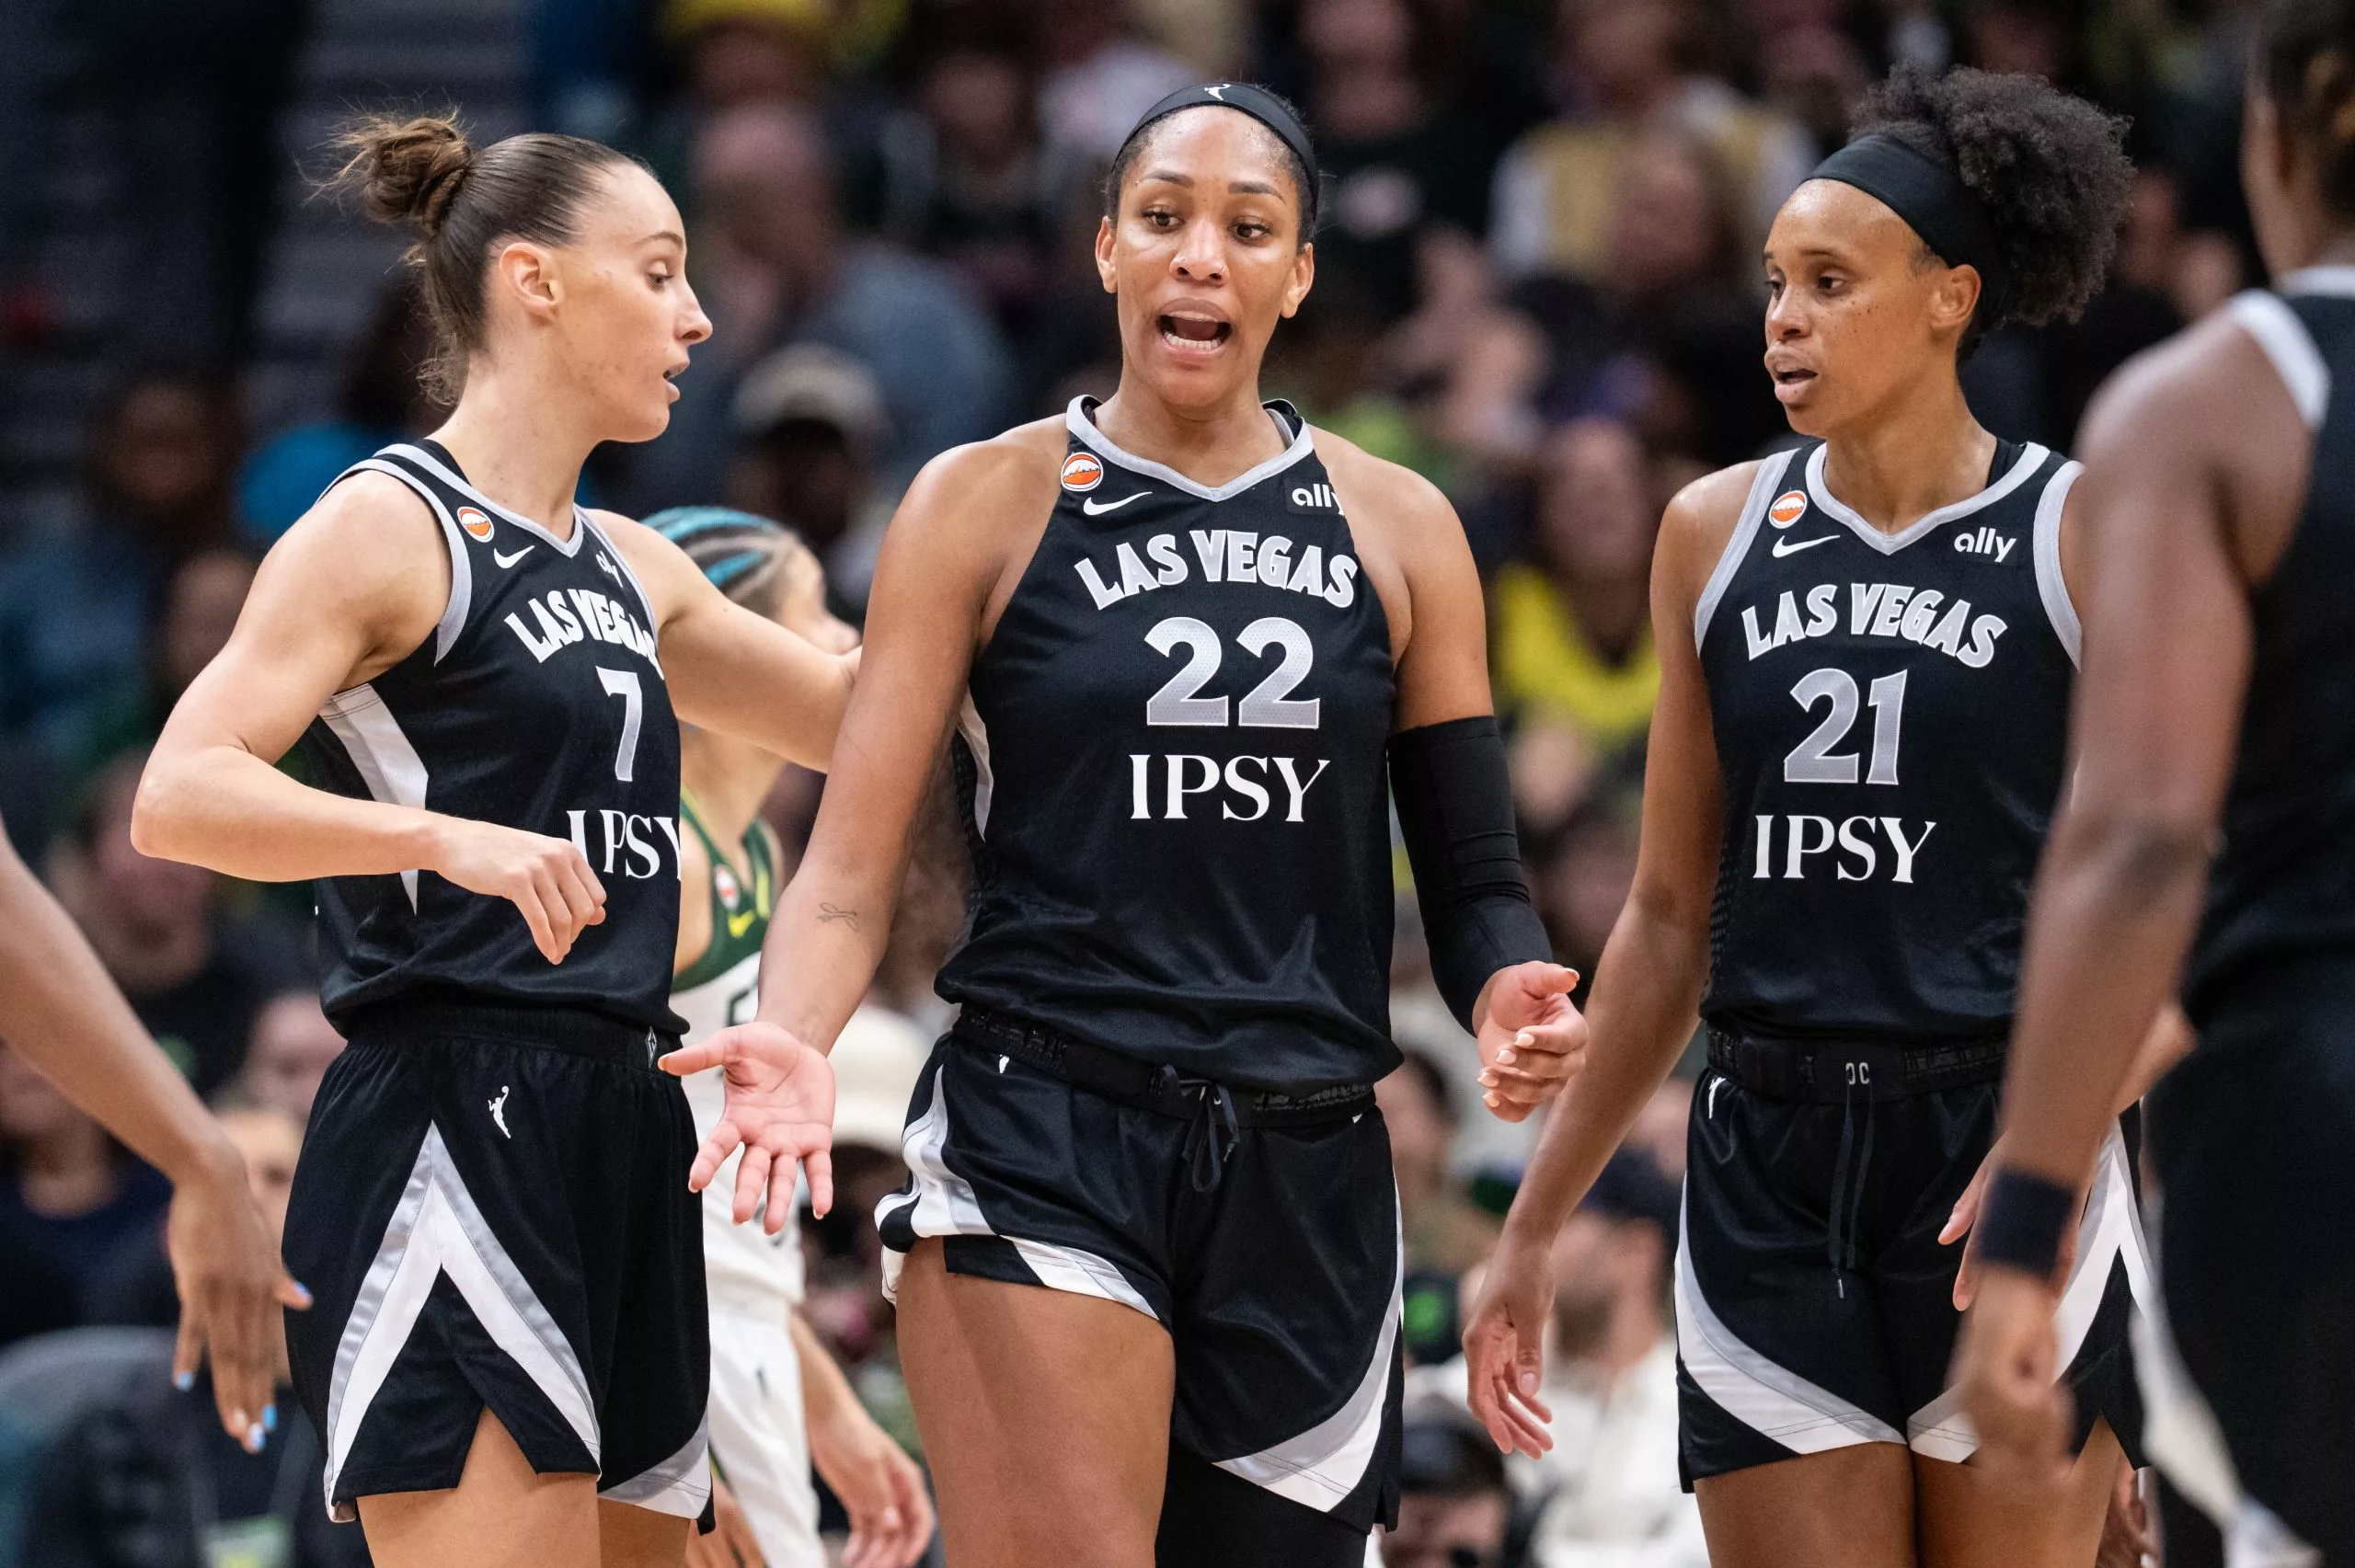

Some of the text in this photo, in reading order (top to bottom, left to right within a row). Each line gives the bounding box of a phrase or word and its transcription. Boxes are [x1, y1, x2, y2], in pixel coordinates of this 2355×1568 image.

[1074, 530, 1359, 611] LAS VEGAS
[1954, 527, 2017, 563] ally
[503, 589, 584, 663] LAS
[1741, 583, 2007, 669] LAS VEGAS
[1144, 617, 1320, 729] 22
[595, 666, 642, 782] 7
[1784, 668, 1908, 785] 21
[1130, 754, 1331, 822] IPSY
[1752, 815, 1936, 884] IPSY
